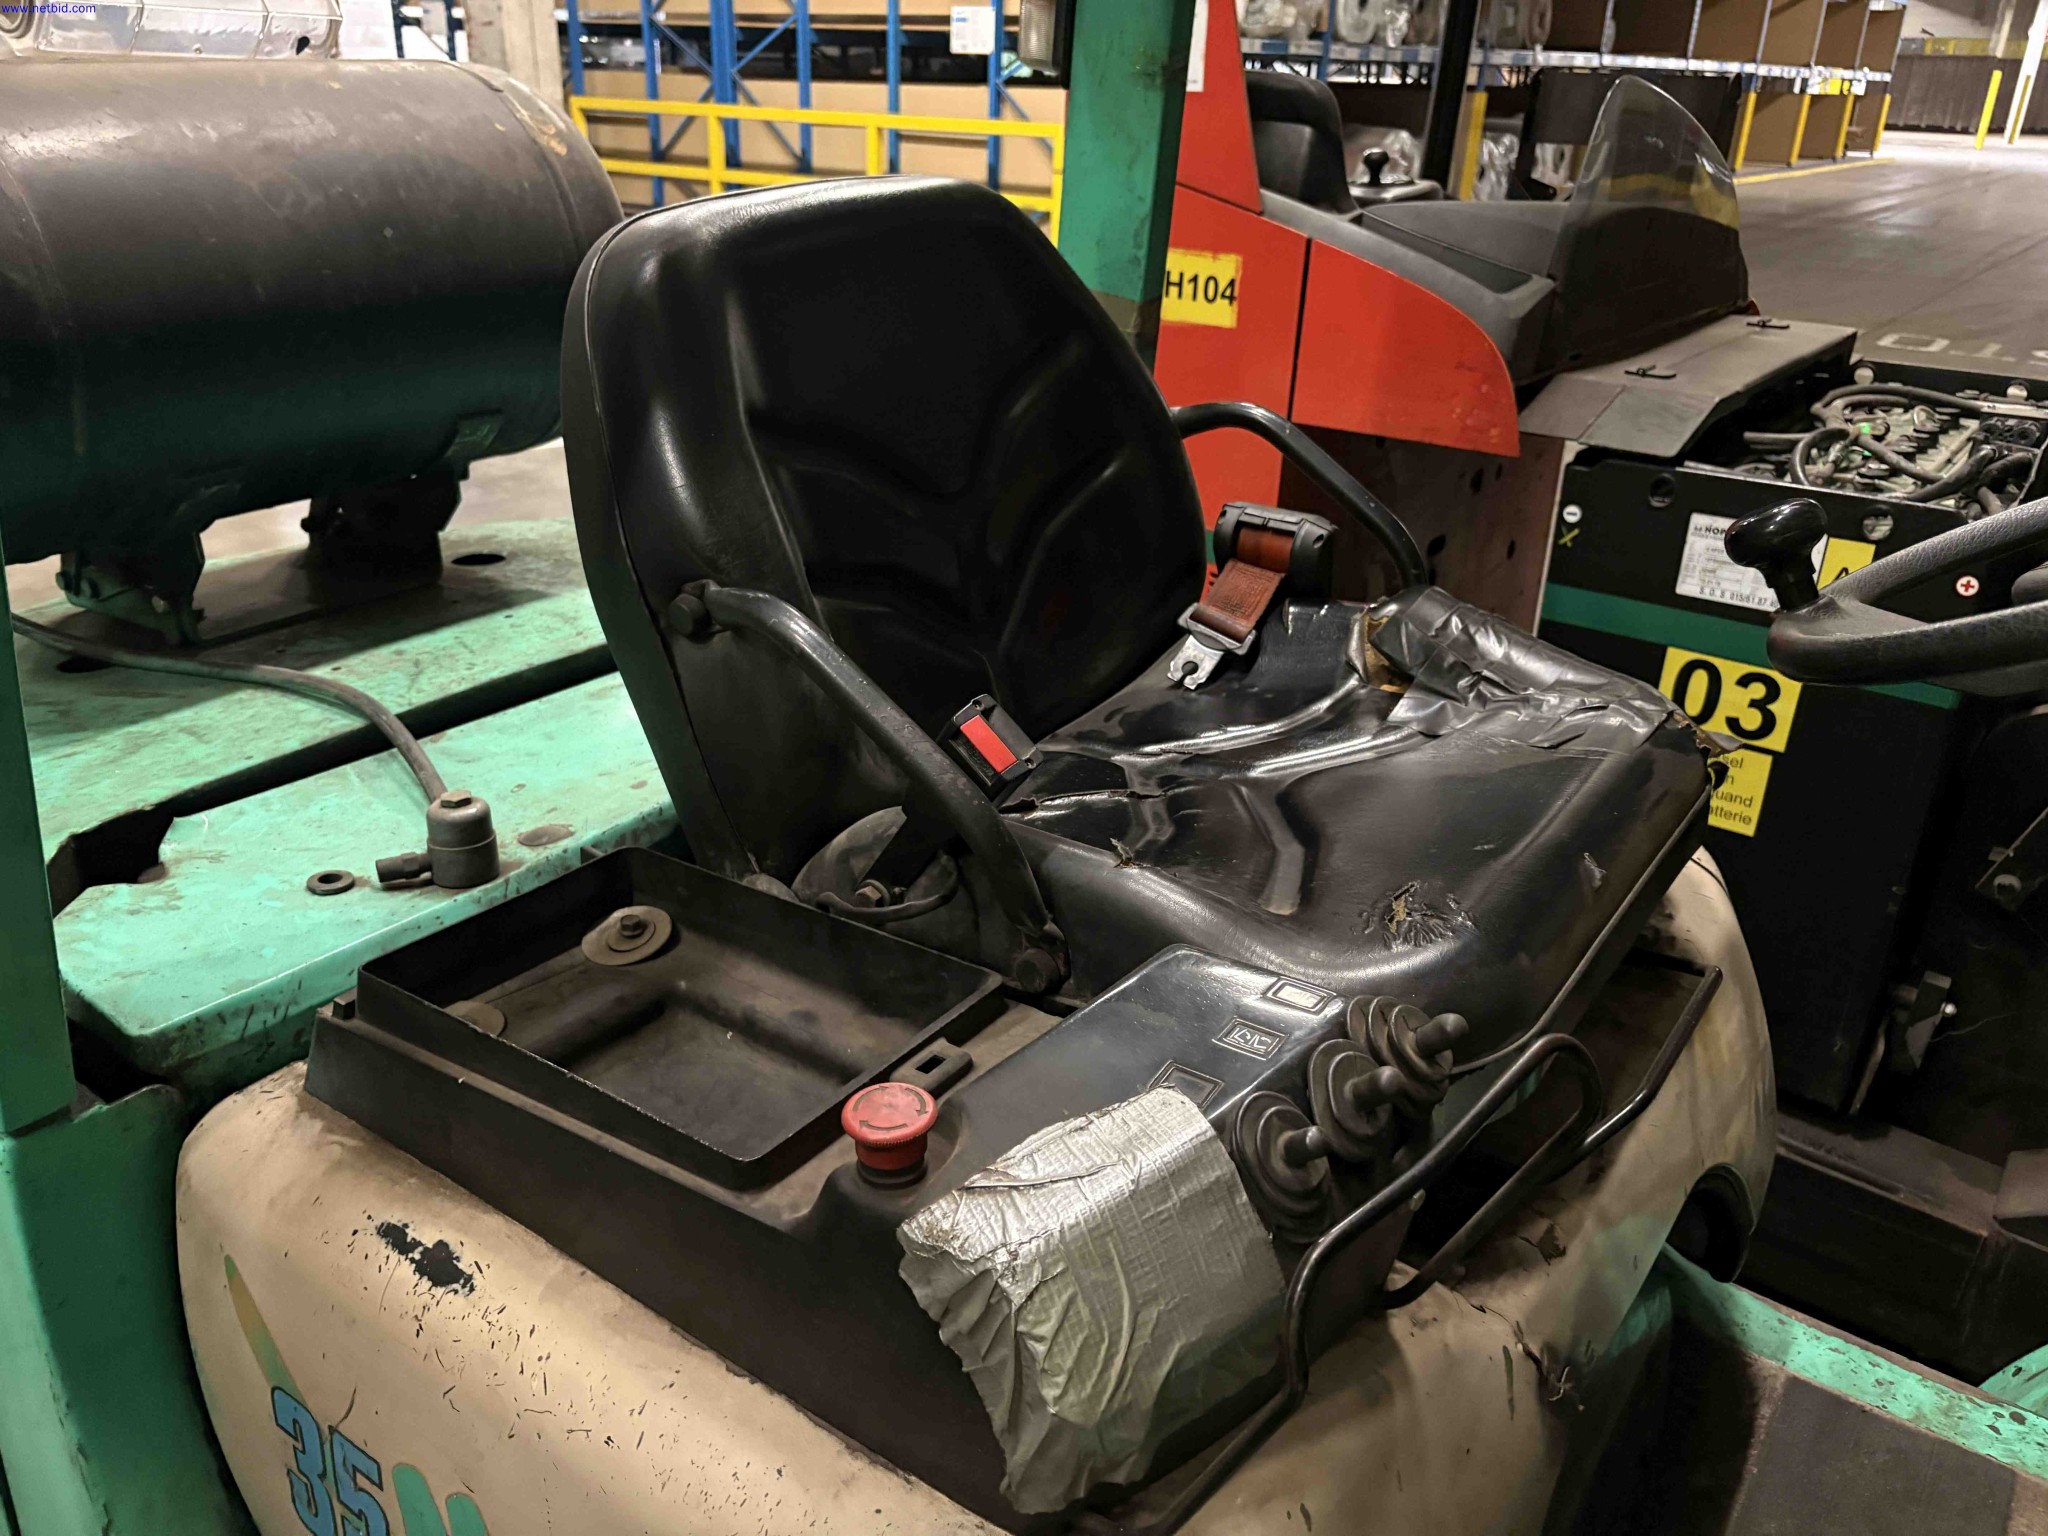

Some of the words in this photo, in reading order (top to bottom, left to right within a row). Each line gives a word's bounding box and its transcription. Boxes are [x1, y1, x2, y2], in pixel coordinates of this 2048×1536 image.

[1165, 270, 1237, 306] H104
[1672, 658, 1781, 741] 03
[1721, 755, 1744, 769] sel
[1711, 790, 1754, 808] uand
[1710, 805, 1752, 826] tterie
[271, 1386, 390, 1536] 35
